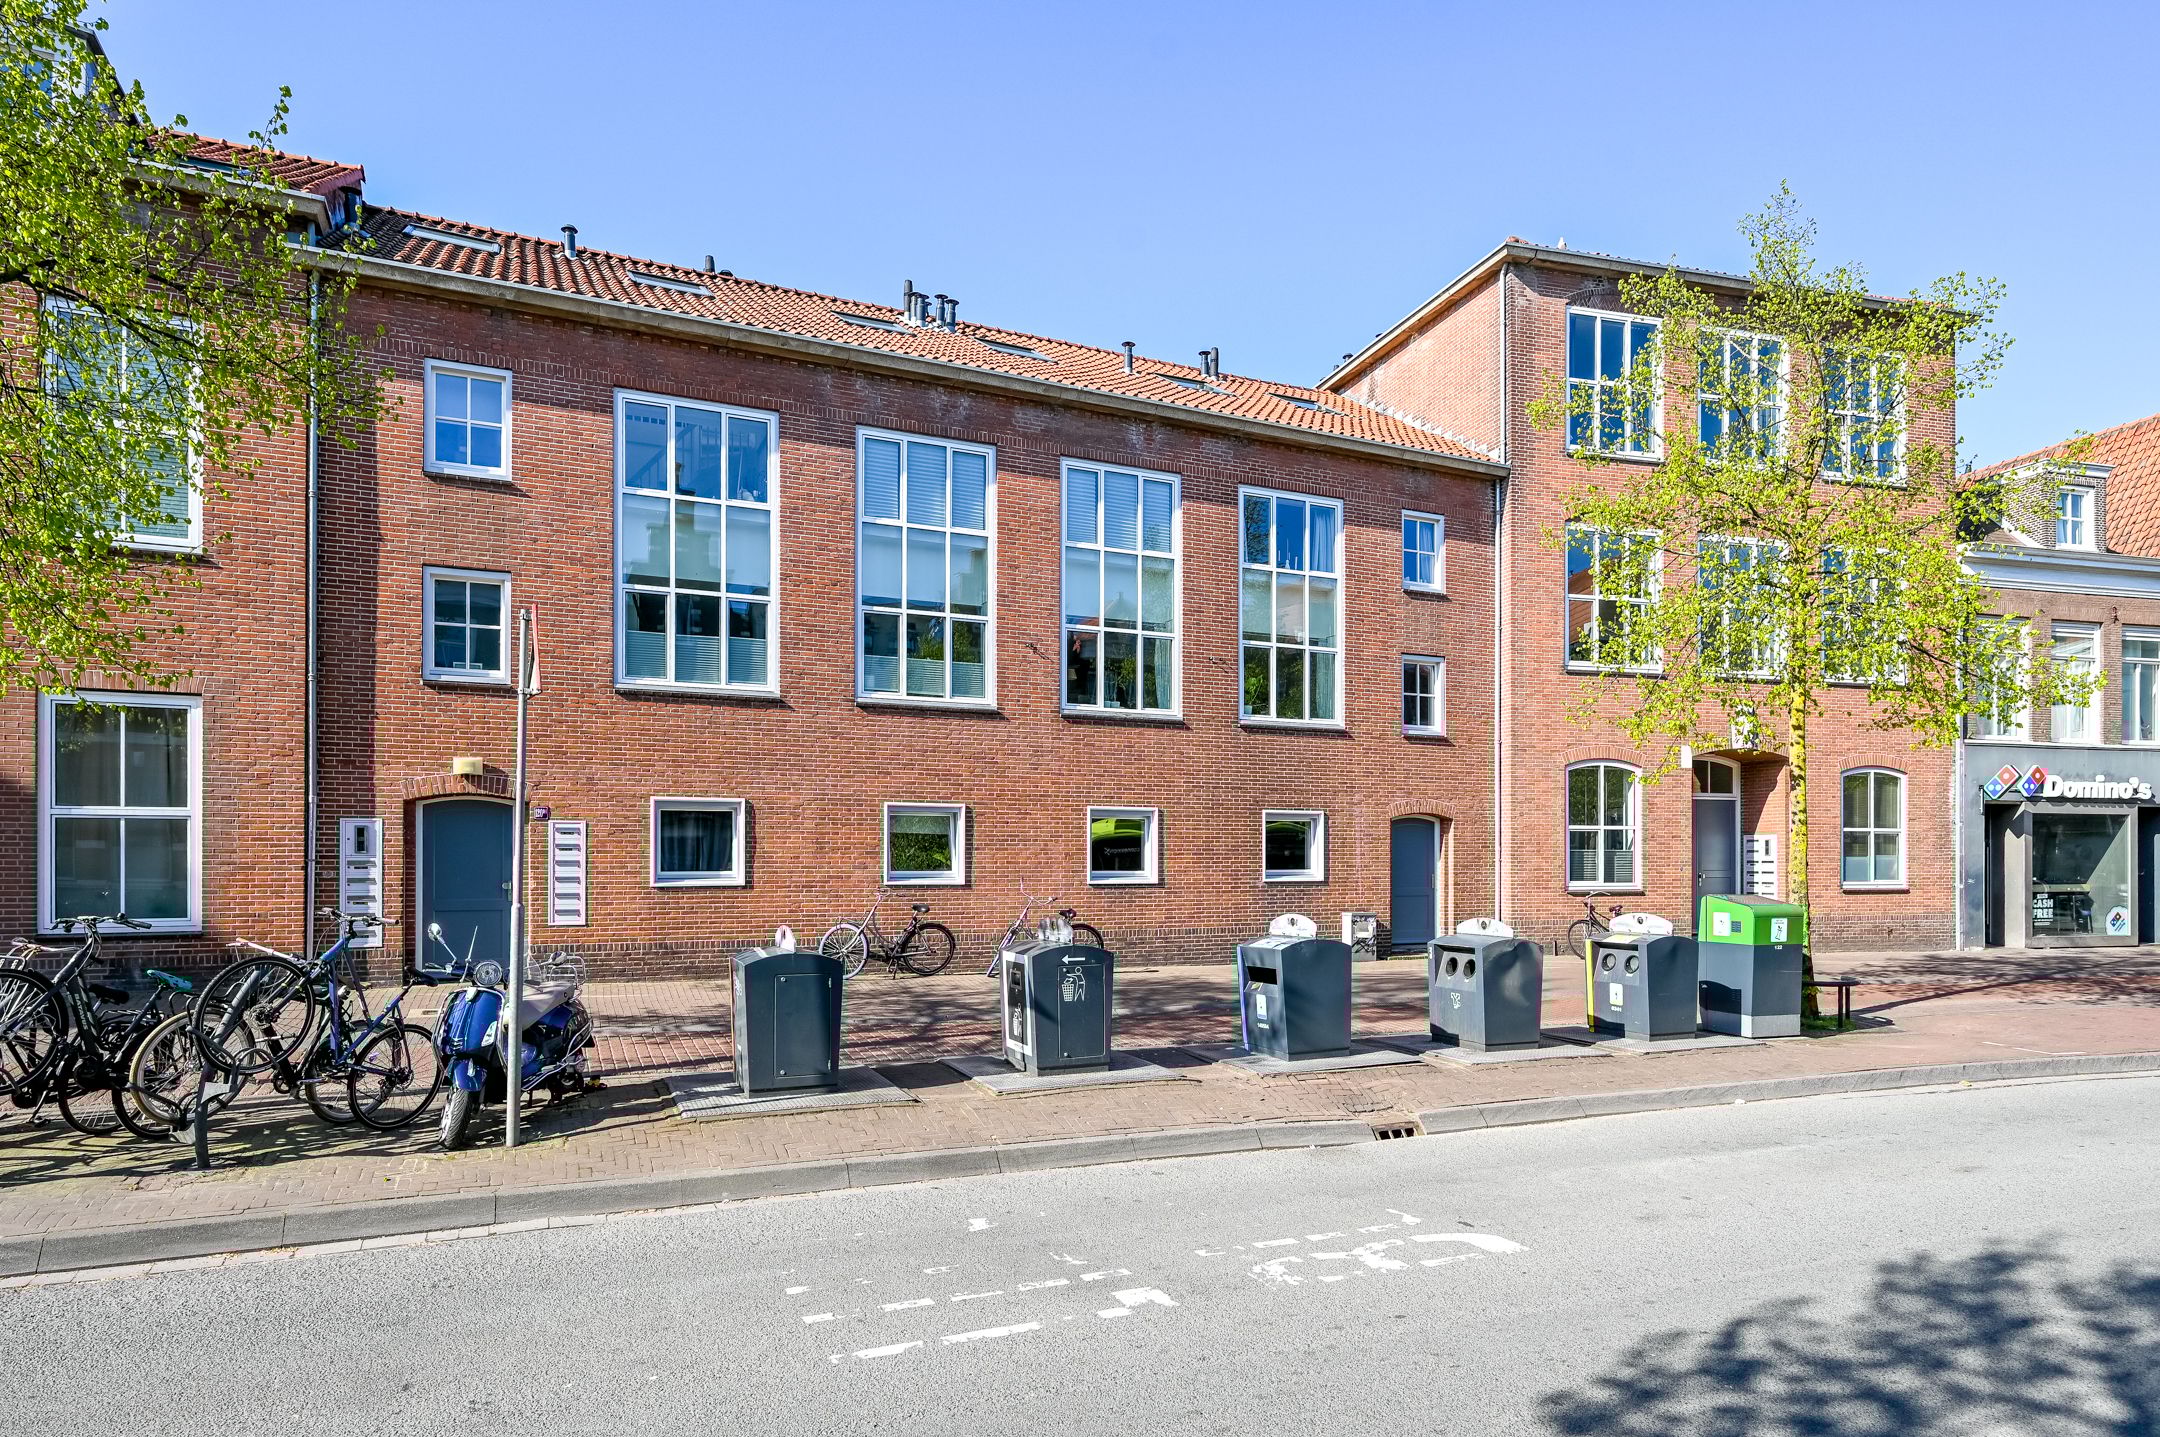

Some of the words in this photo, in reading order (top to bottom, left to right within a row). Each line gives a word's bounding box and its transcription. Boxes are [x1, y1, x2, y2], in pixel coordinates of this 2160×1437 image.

[2043, 774, 2152, 799] Domino's
[2033, 899, 2053, 908] CASH
[2033, 908, 2053, 918] FREE
